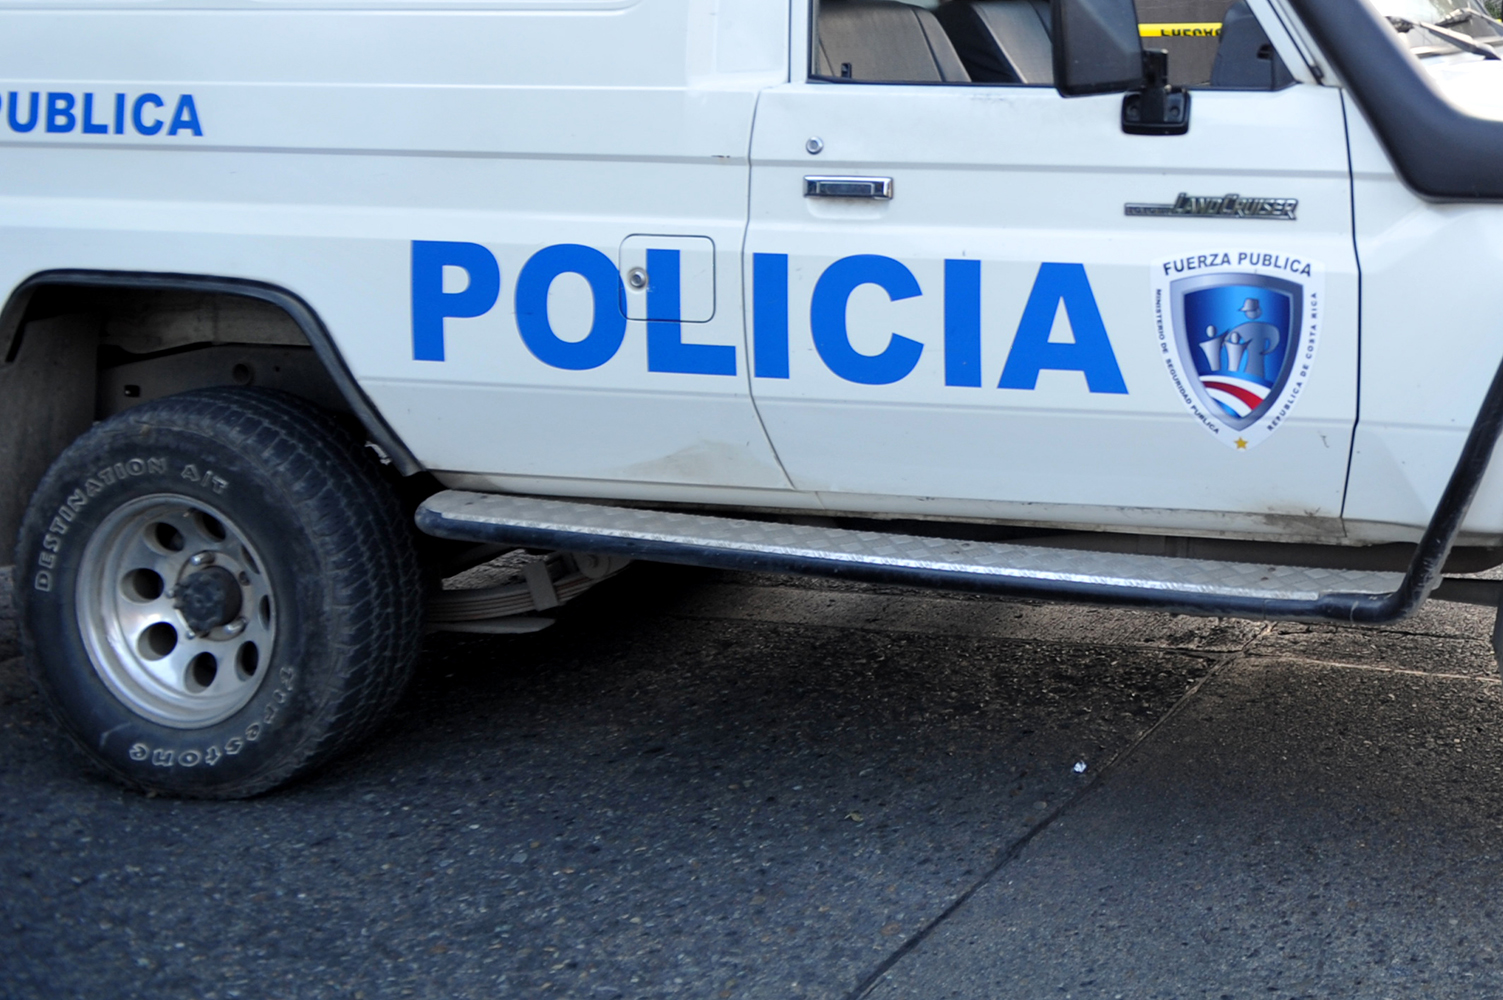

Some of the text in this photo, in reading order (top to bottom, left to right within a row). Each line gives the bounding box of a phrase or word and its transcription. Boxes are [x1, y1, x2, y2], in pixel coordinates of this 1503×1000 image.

[0, 91, 203, 137] UBLICA
[411, 240, 1129, 395] POLICIA
[1163, 252, 1312, 277] FUERZA PUBLICA
[1155, 288, 1221, 435] MINISTERIO DE SEGURIDAD PUBLICA
[1266, 292, 1318, 432] REPUBLICA DE COSTA RICA
[34, 457, 229, 593] DESTINATION A/T
